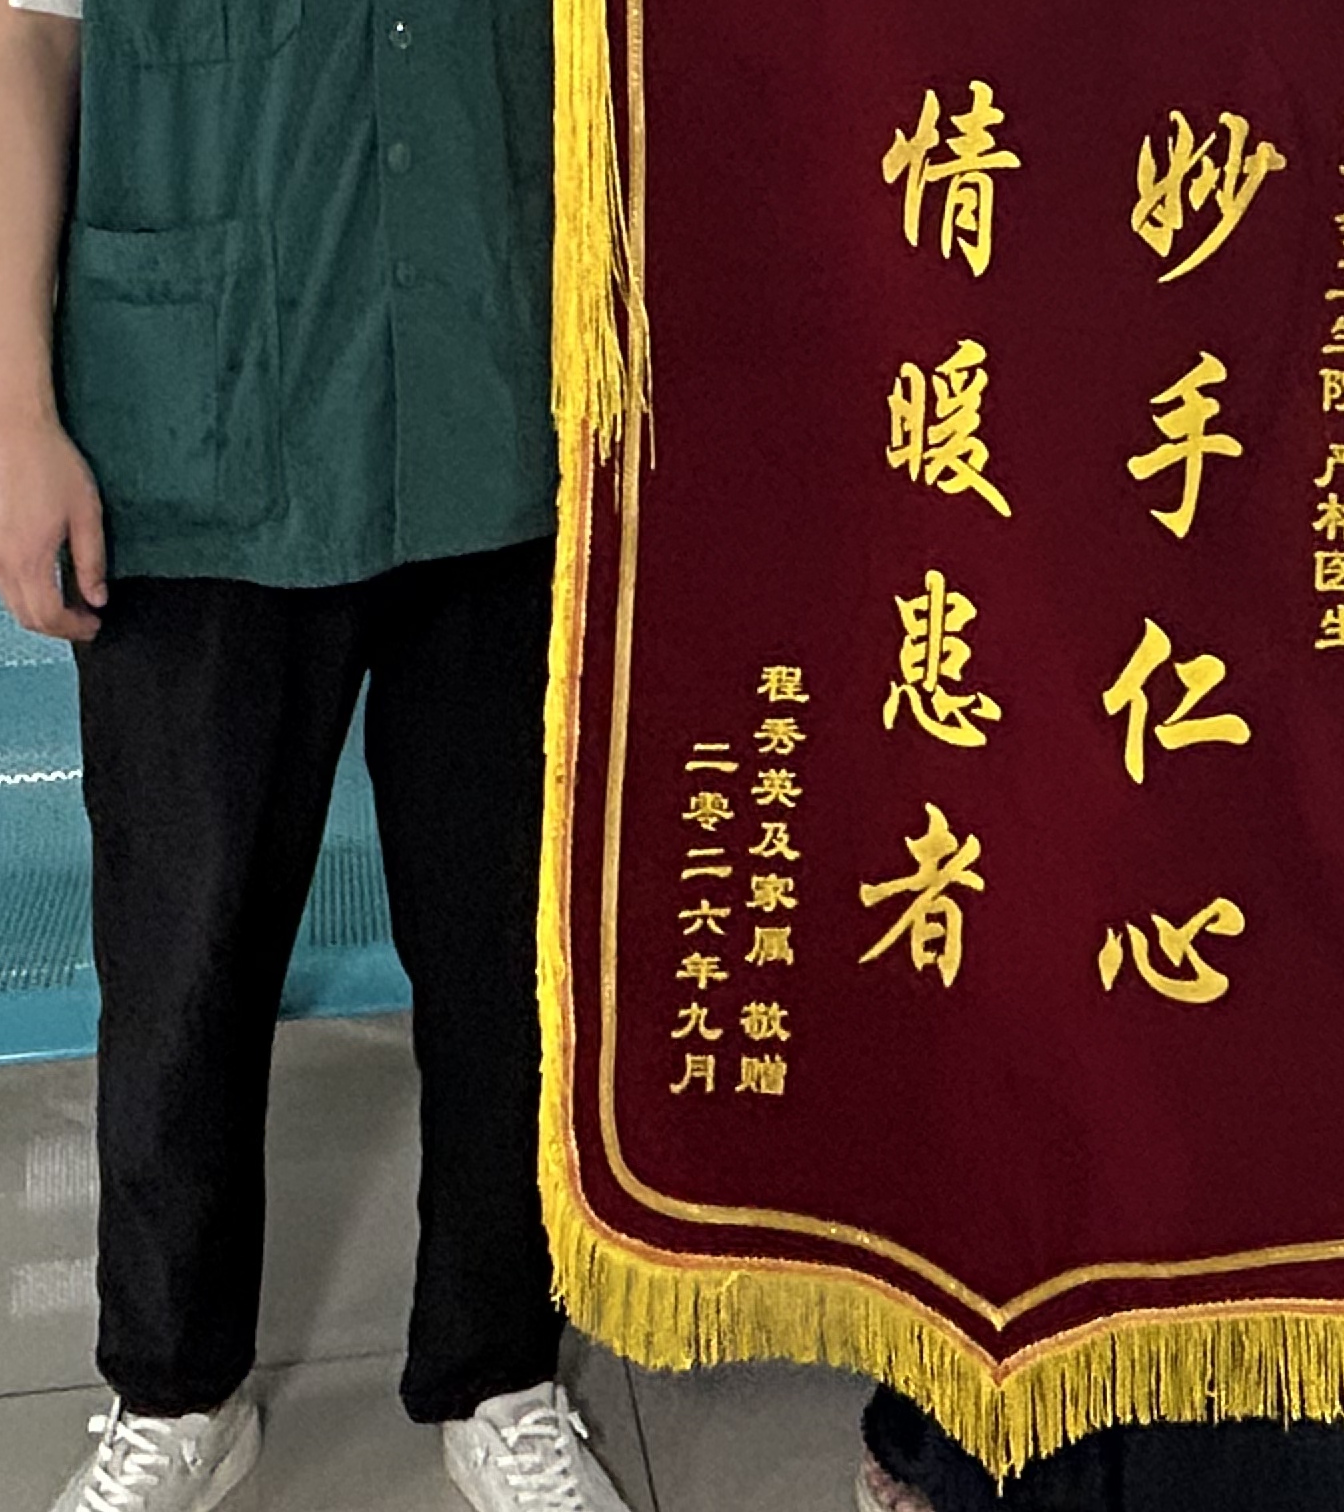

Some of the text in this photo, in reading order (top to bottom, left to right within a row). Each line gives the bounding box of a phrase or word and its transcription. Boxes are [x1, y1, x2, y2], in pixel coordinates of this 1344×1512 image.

[858, 80, 1022, 988] 情暖患者
[1098, 110, 1288, 1004] 妙手仁心
[669, 742, 740, 1094] 二零二六年九月
[734, 665, 810, 1096] 程秀英及家属 敬赠
